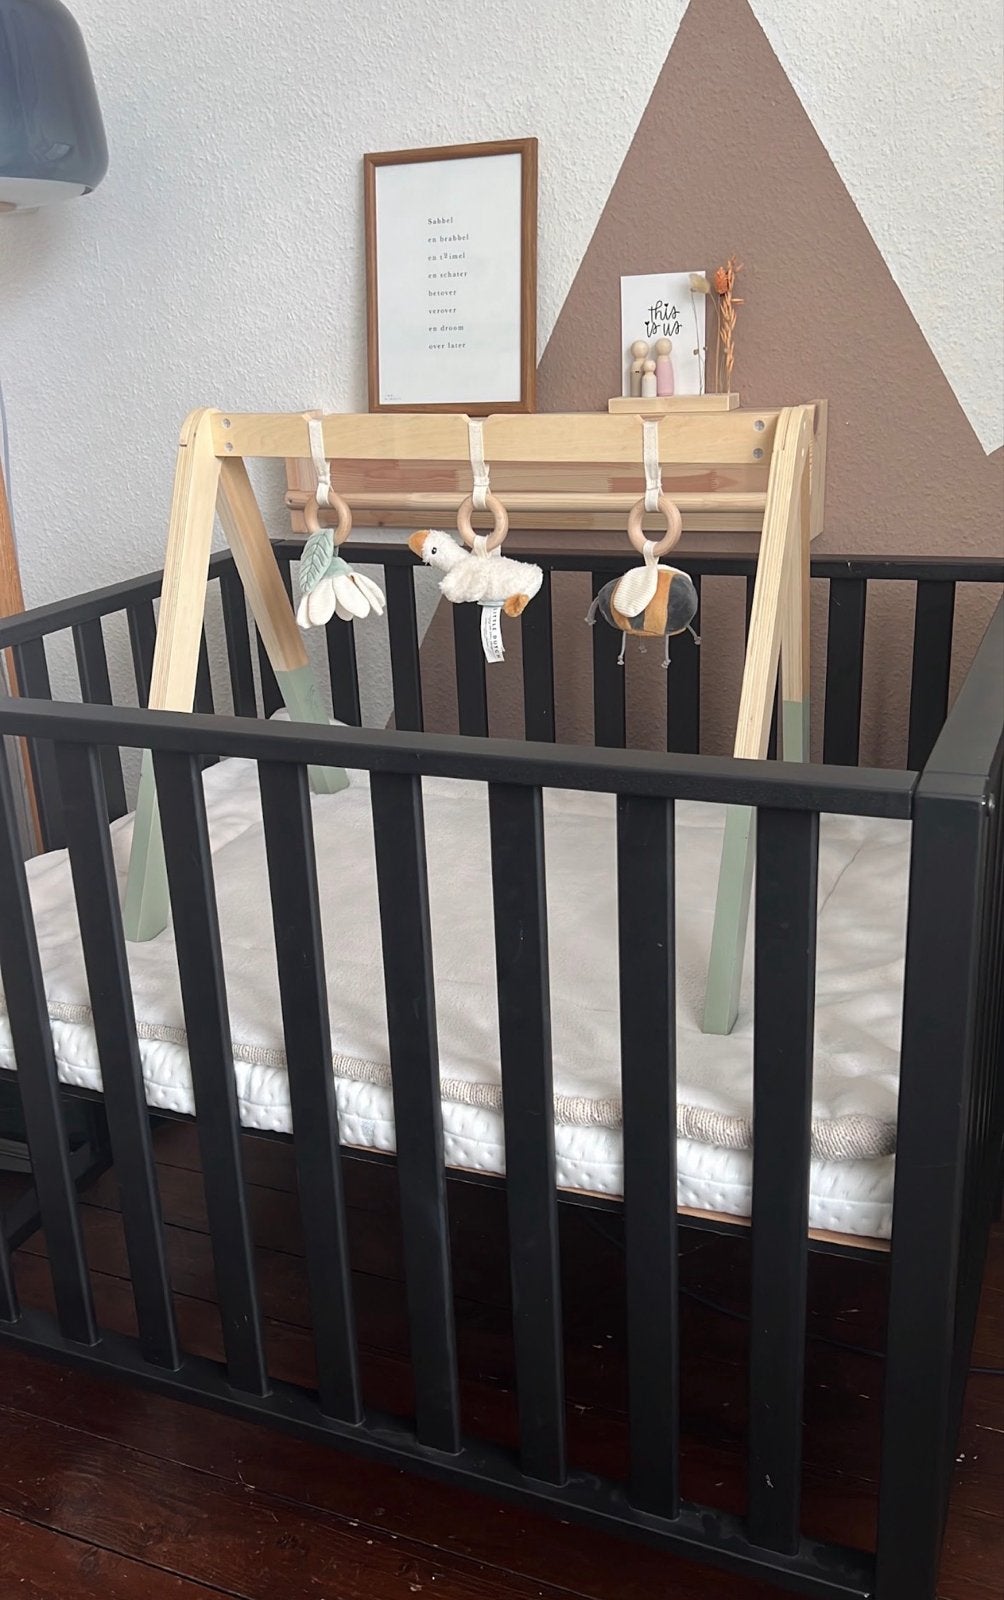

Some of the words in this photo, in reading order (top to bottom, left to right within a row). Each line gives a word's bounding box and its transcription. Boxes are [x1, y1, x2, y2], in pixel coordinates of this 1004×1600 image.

[427, 216, 454, 225] Sabbel
[439, 233, 469, 242] brabbel
[647, 300, 680, 323] this
[644, 321, 661, 338] is
[663, 320, 683, 337] us
